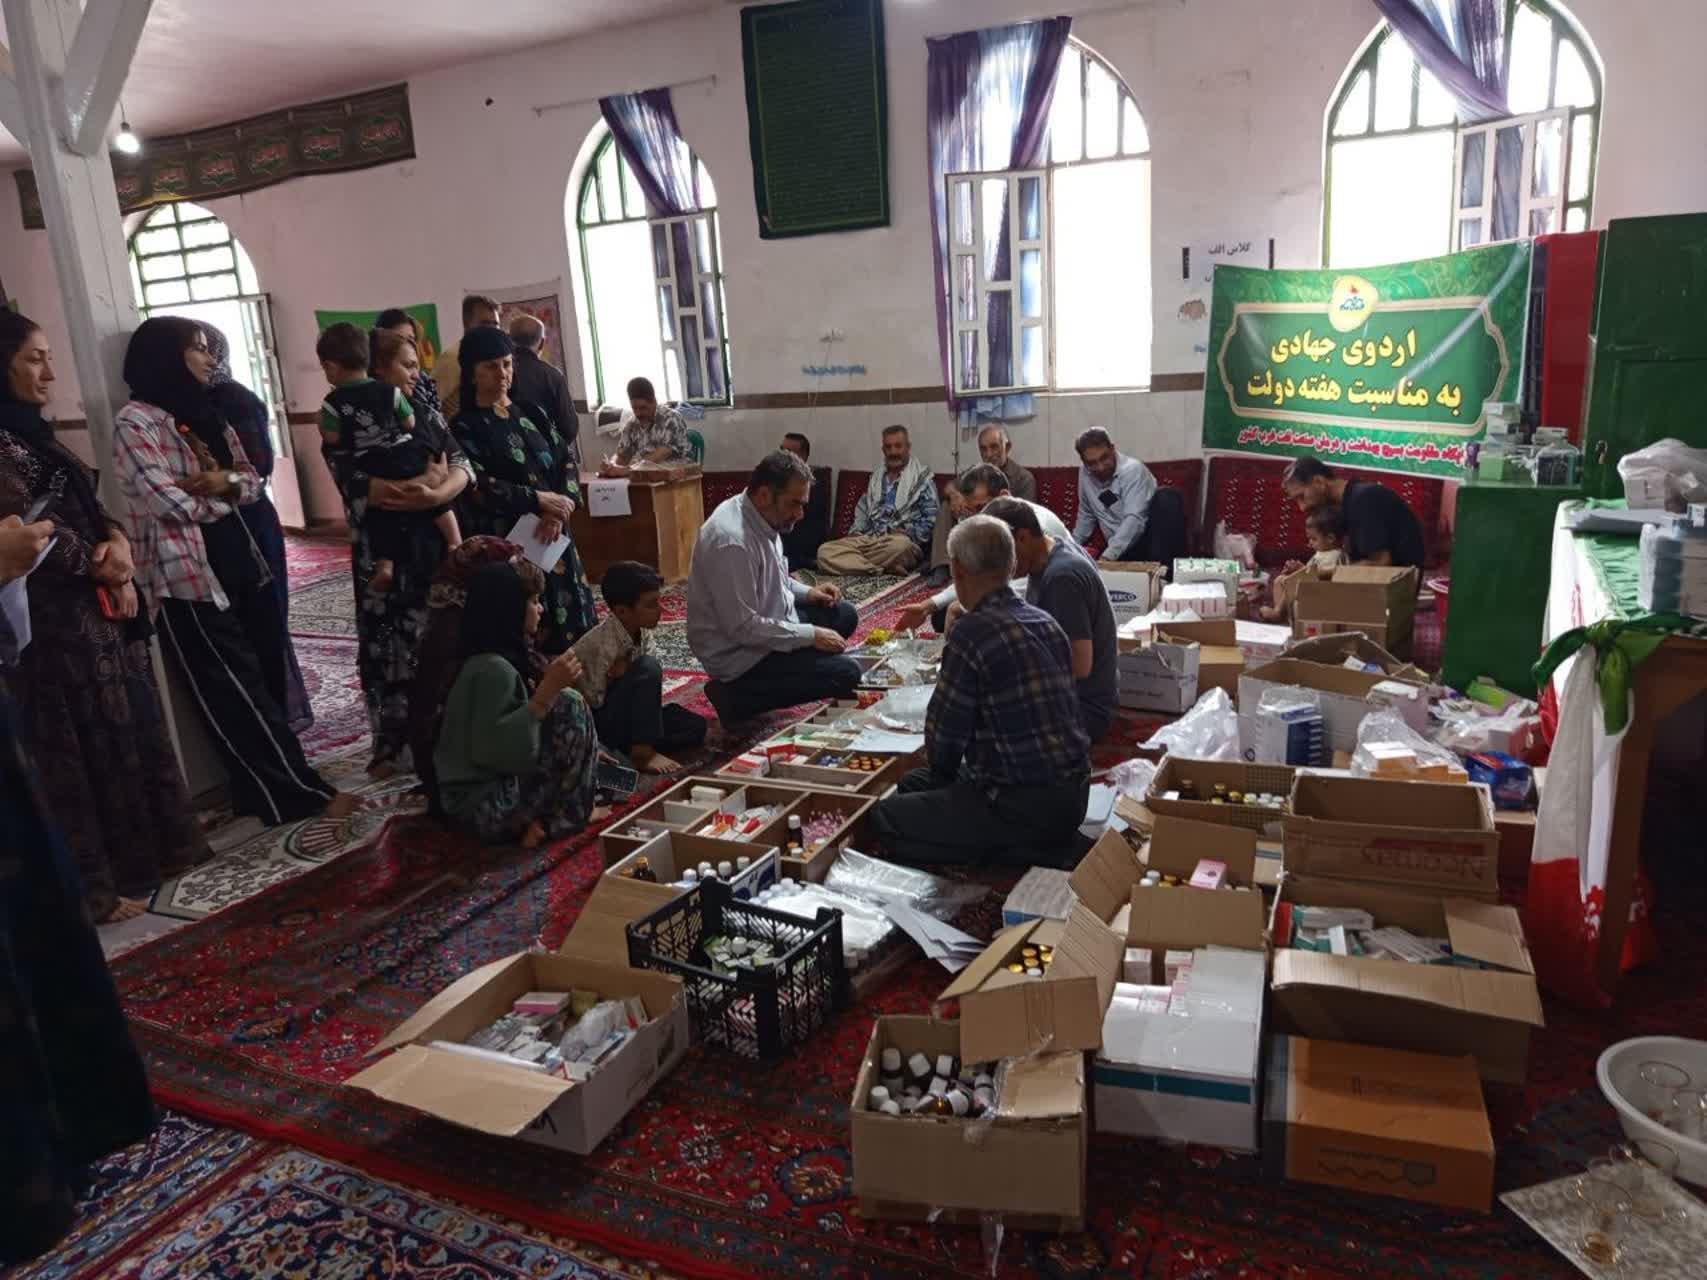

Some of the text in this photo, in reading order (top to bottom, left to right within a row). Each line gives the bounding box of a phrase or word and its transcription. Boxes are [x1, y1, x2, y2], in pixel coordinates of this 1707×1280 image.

[1270, 328, 1416, 368] اردوی جهادی
[1247, 368, 1462, 416] به مناسبت هفته دولت
